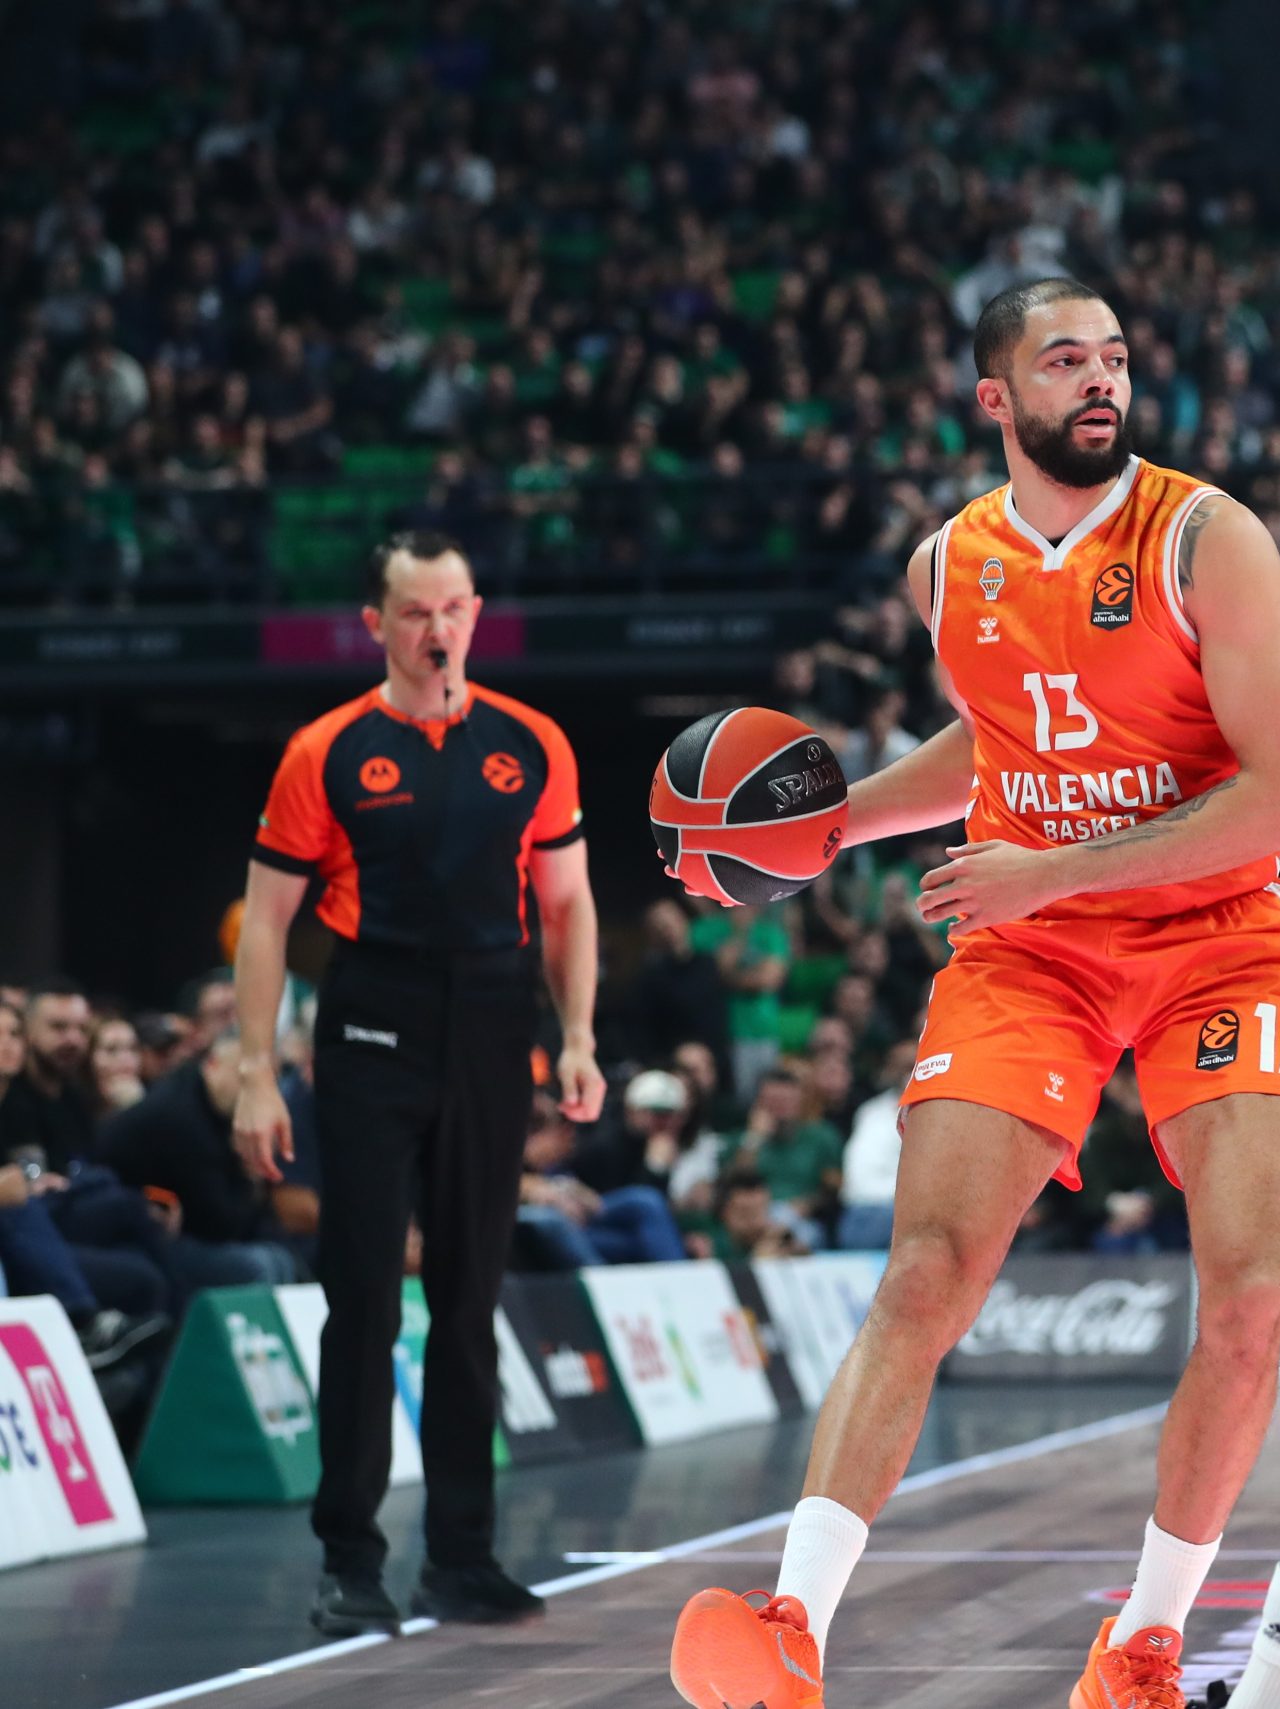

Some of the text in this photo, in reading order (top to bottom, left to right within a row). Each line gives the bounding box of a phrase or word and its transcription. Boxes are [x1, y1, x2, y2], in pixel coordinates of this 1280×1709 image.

[1023, 672, 1099, 752] 13
[768, 763, 843, 813] SPALD
[1000, 761, 1183, 814] VALENCIA
